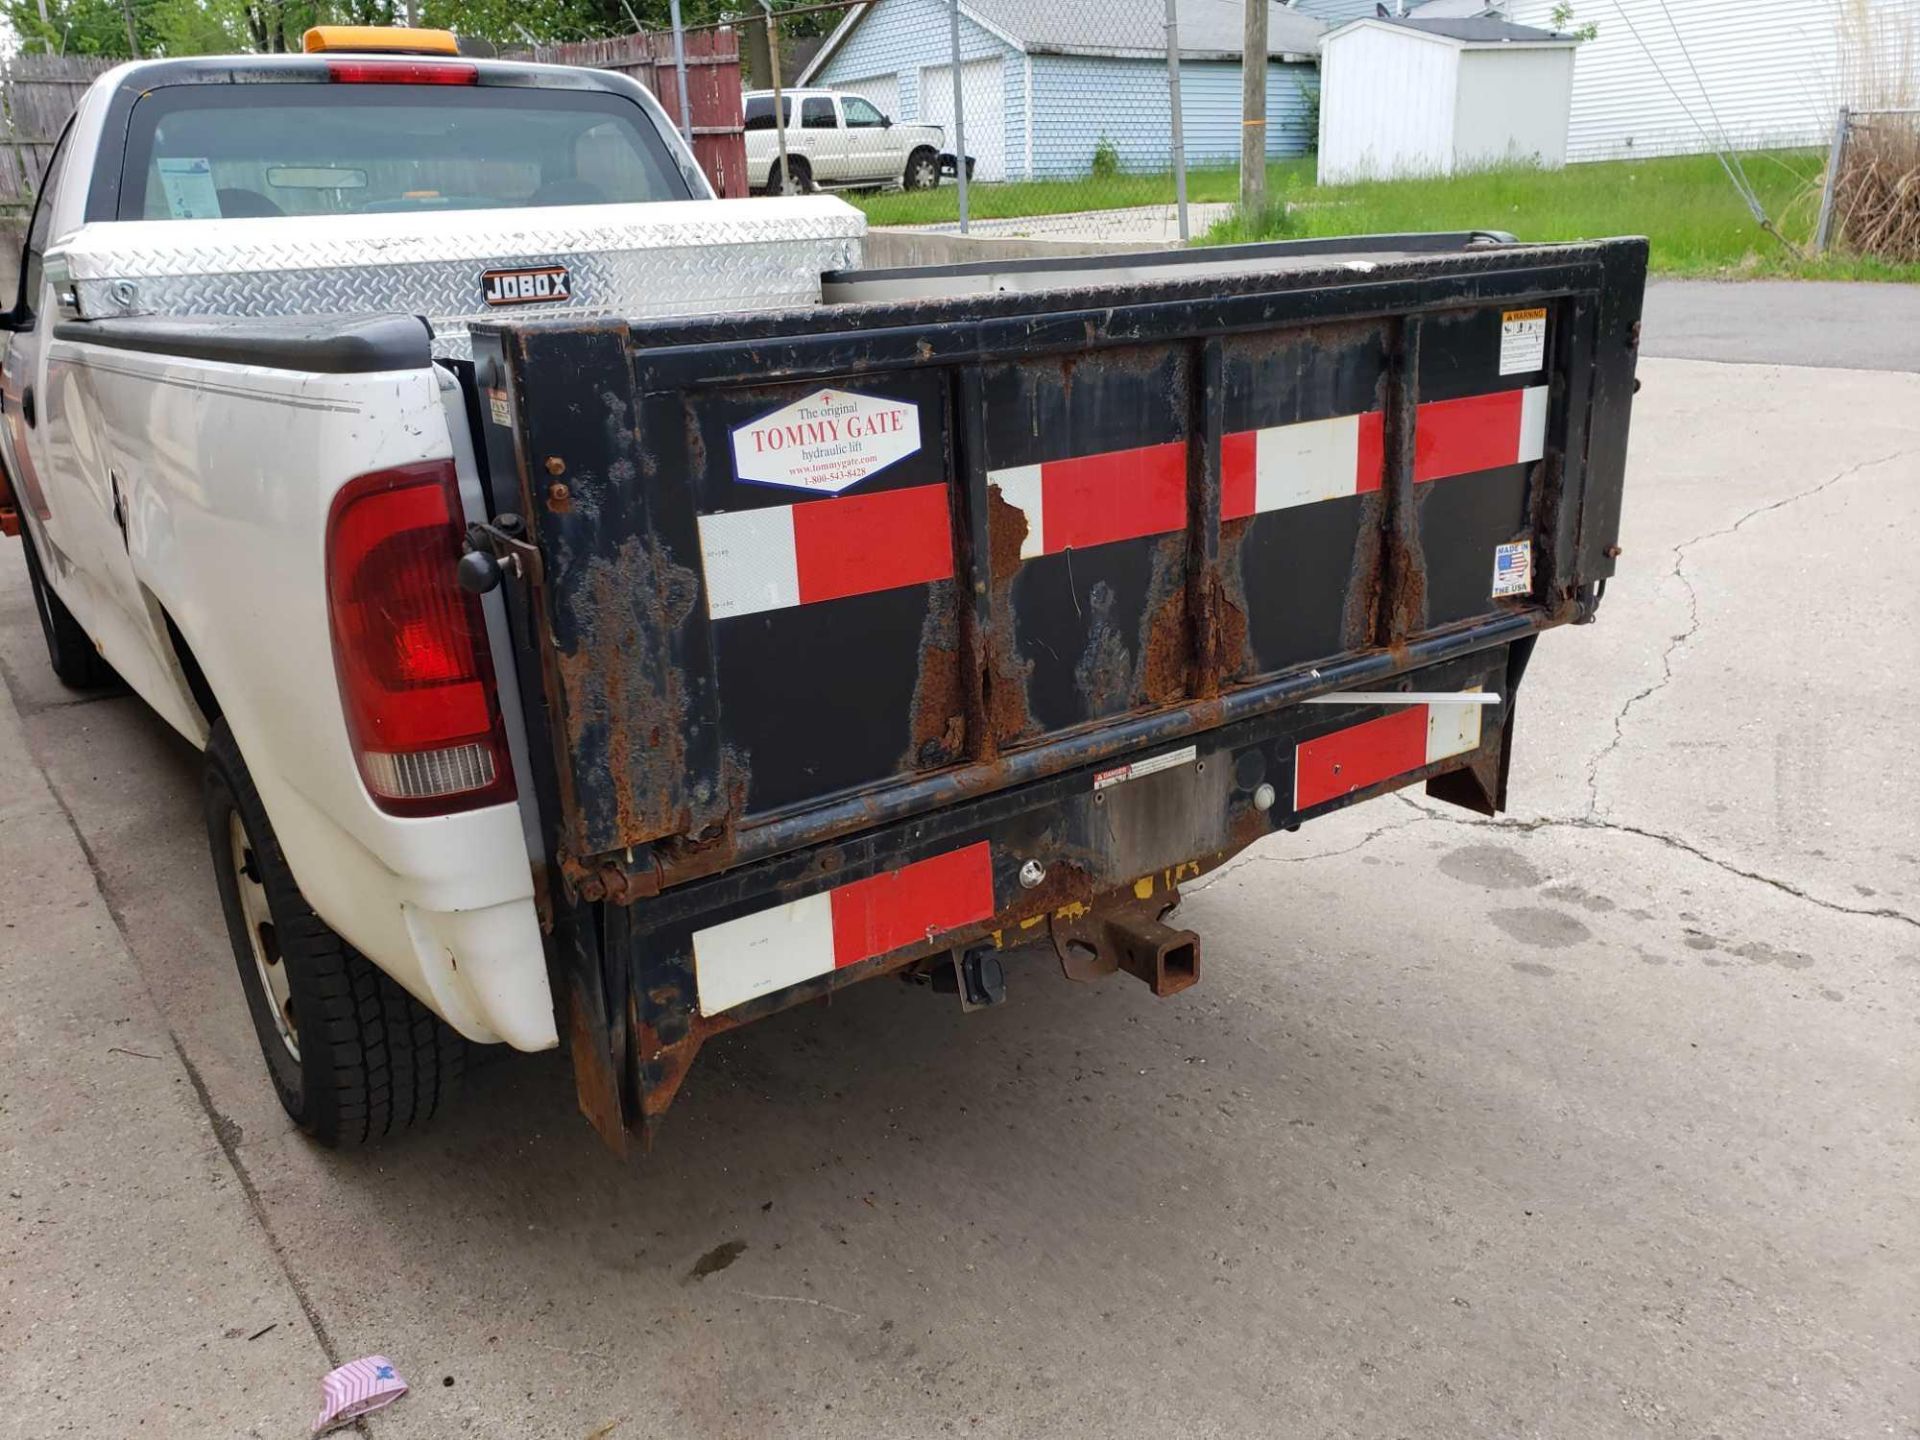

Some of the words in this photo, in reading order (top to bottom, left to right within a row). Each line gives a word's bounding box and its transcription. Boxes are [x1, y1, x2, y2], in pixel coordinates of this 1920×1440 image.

[487, 272, 568, 299] JOBOX
[1513, 309, 1544, 320] WARNING
[798, 408, 818, 420] The
[820, 402, 858, 418] original
[752, 419, 840, 453] TOMMY
[847, 410, 904, 439] GATE
[802, 443, 847, 462] hydraulic
[849, 441, 863, 453] lift
[789, 455, 878, 476] www.tommygate.com
[804, 467, 867, 486] 1-800-543-8428
[1511, 583, 1527, 591] USA
